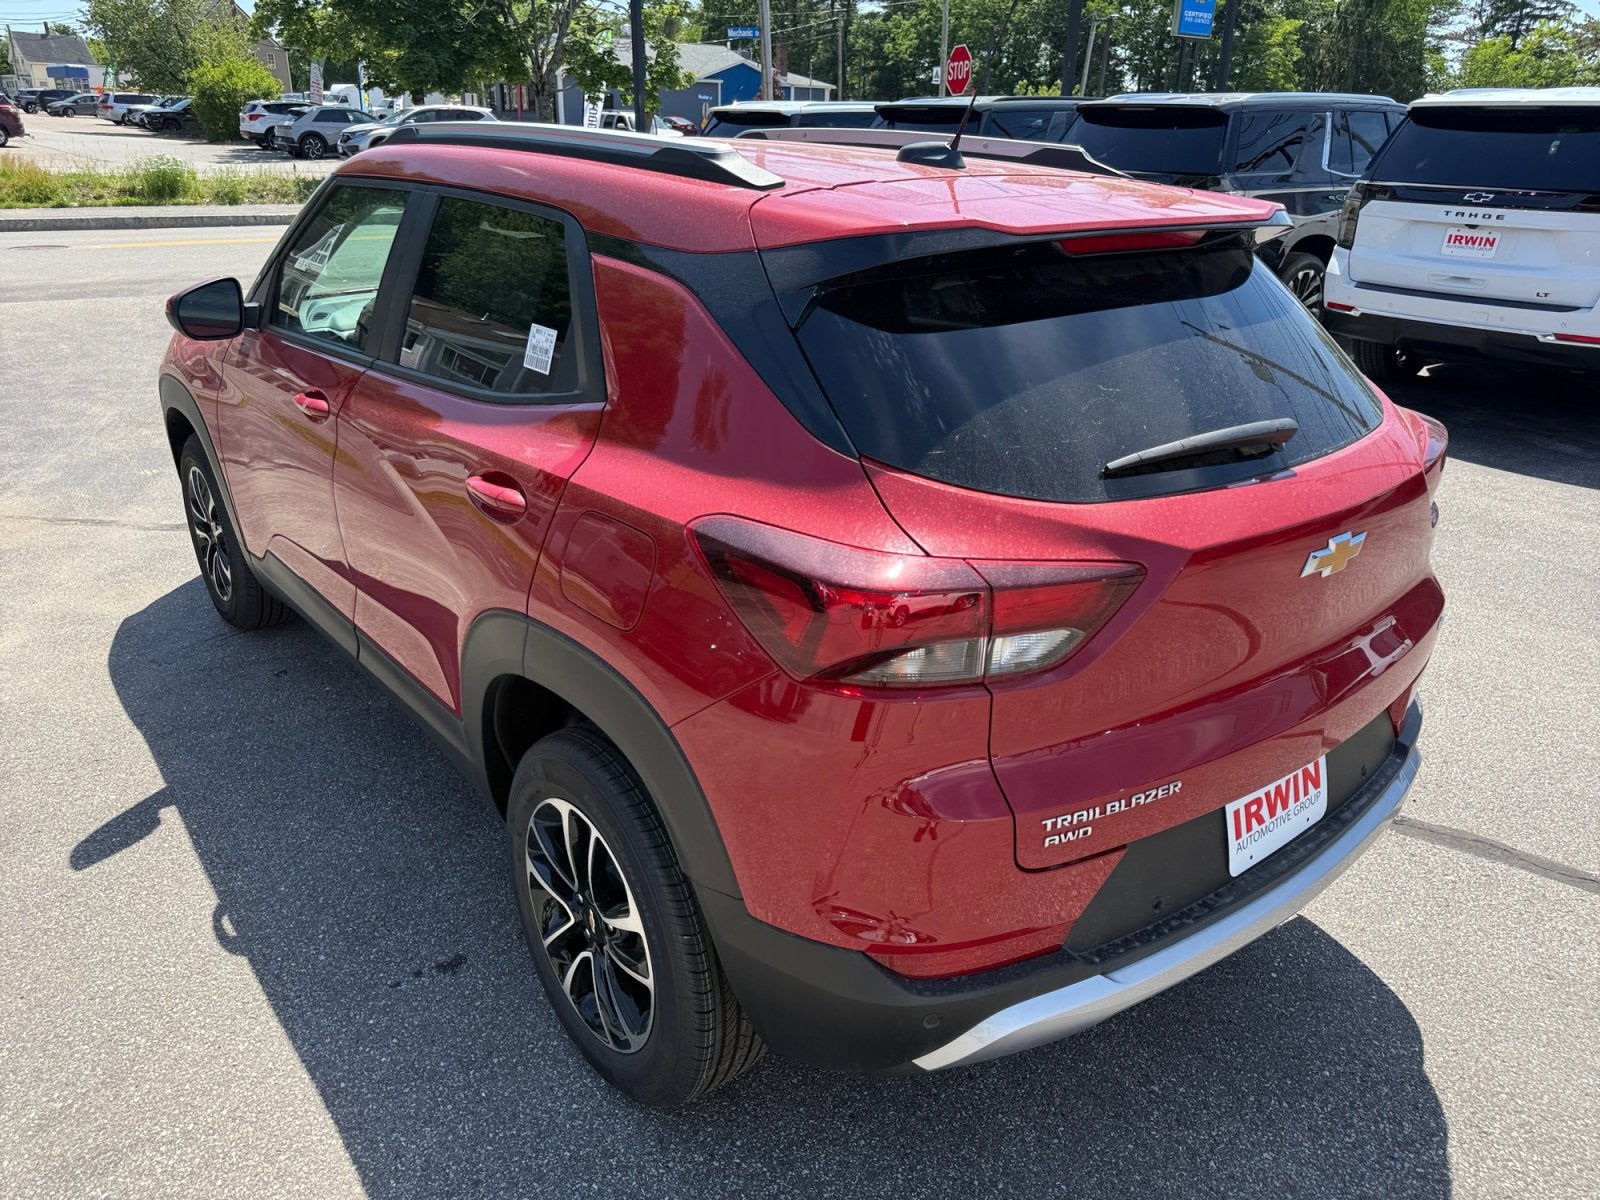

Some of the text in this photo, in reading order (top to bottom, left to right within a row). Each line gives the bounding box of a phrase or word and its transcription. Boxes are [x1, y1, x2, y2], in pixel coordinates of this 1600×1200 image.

[1184, 10, 1212, 19] CERTIFIED
[727, 28, 753, 38] Mechanic
[947, 60, 970, 80] STOP
[1444, 210, 1506, 220] TAHOE
[1446, 233, 1497, 248] IRWIN
[1041, 780, 1182, 832] TRAILBLAZER
[1233, 759, 1321, 843] IRWIN
[1236, 790, 1322, 855] AUTOMOTIVE GROUP
[1044, 826, 1093, 848] AWD
